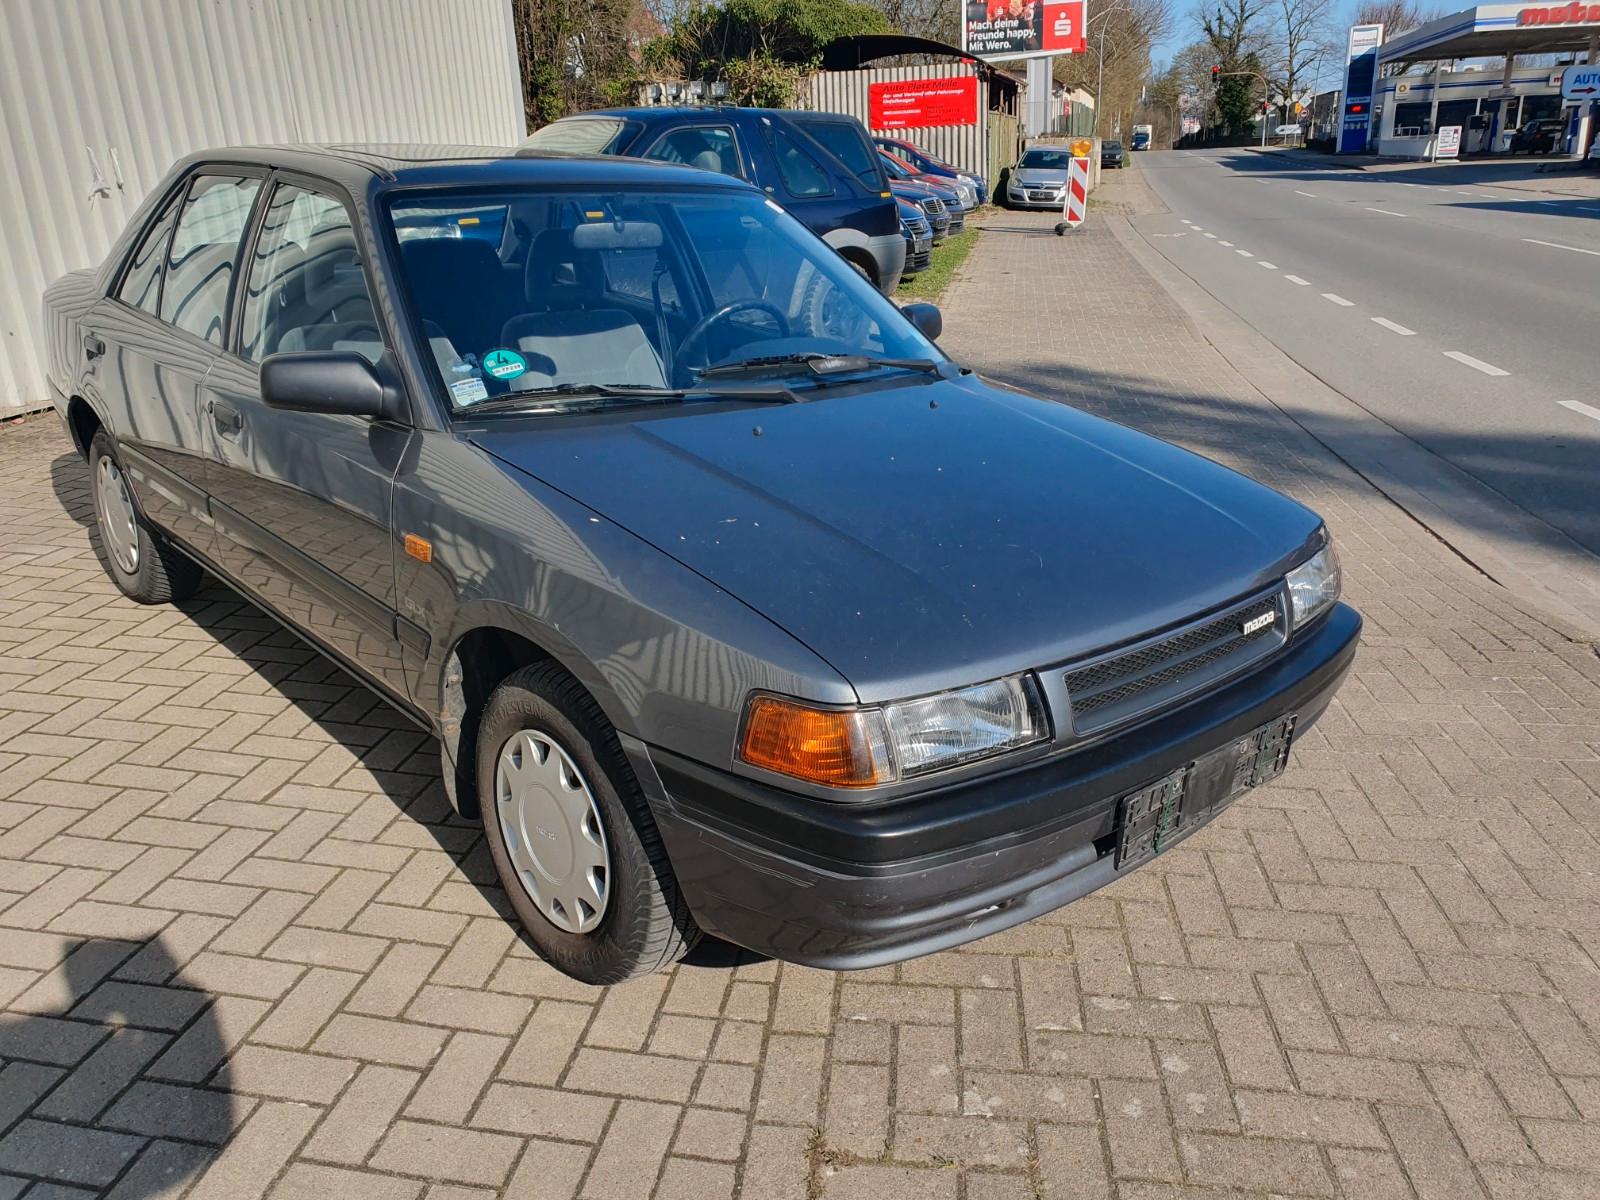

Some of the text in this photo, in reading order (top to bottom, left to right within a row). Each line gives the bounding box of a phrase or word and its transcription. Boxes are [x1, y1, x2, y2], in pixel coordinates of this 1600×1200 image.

[968, 18, 1019, 30] Mach deine
[968, 28, 1037, 41] Freunde happy.
[968, 40, 1012, 51] Mit Wero.
